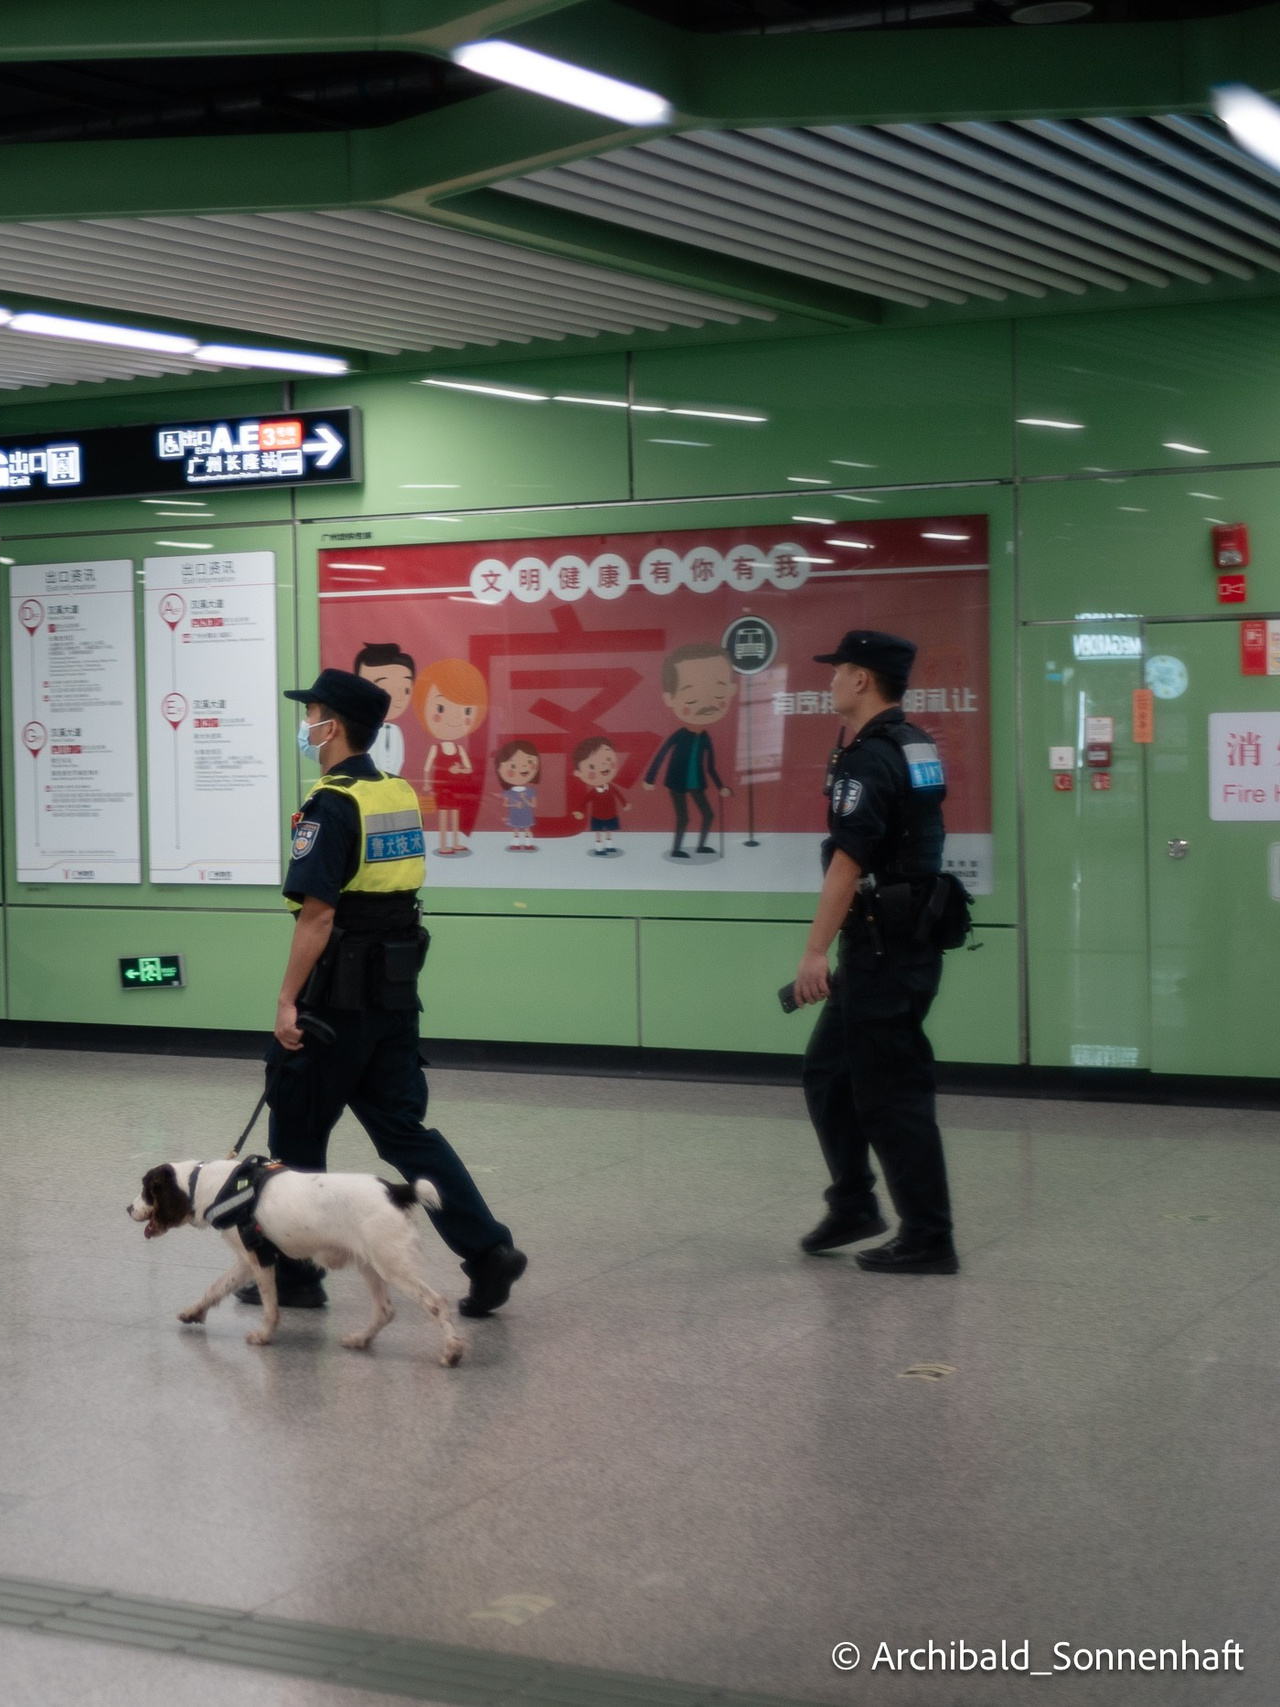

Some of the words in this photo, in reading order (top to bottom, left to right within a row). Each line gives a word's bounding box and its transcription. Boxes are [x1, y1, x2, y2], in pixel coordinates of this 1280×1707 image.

[183, 430, 211, 447] 出口
[9, 451, 47, 475] 出口
[187, 452, 278, 475] 广州长隆站
[45, 568, 96, 584] 出口资讯
[182, 560, 236, 576] 出口资讯
[481, 564, 620, 593] 文明健康
[648, 554, 800, 583] 有你有我
[772, 690, 840, 716] 有序排
[1226, 731, 1280, 767] 消
[1223, 784, 1267, 803] Fire
